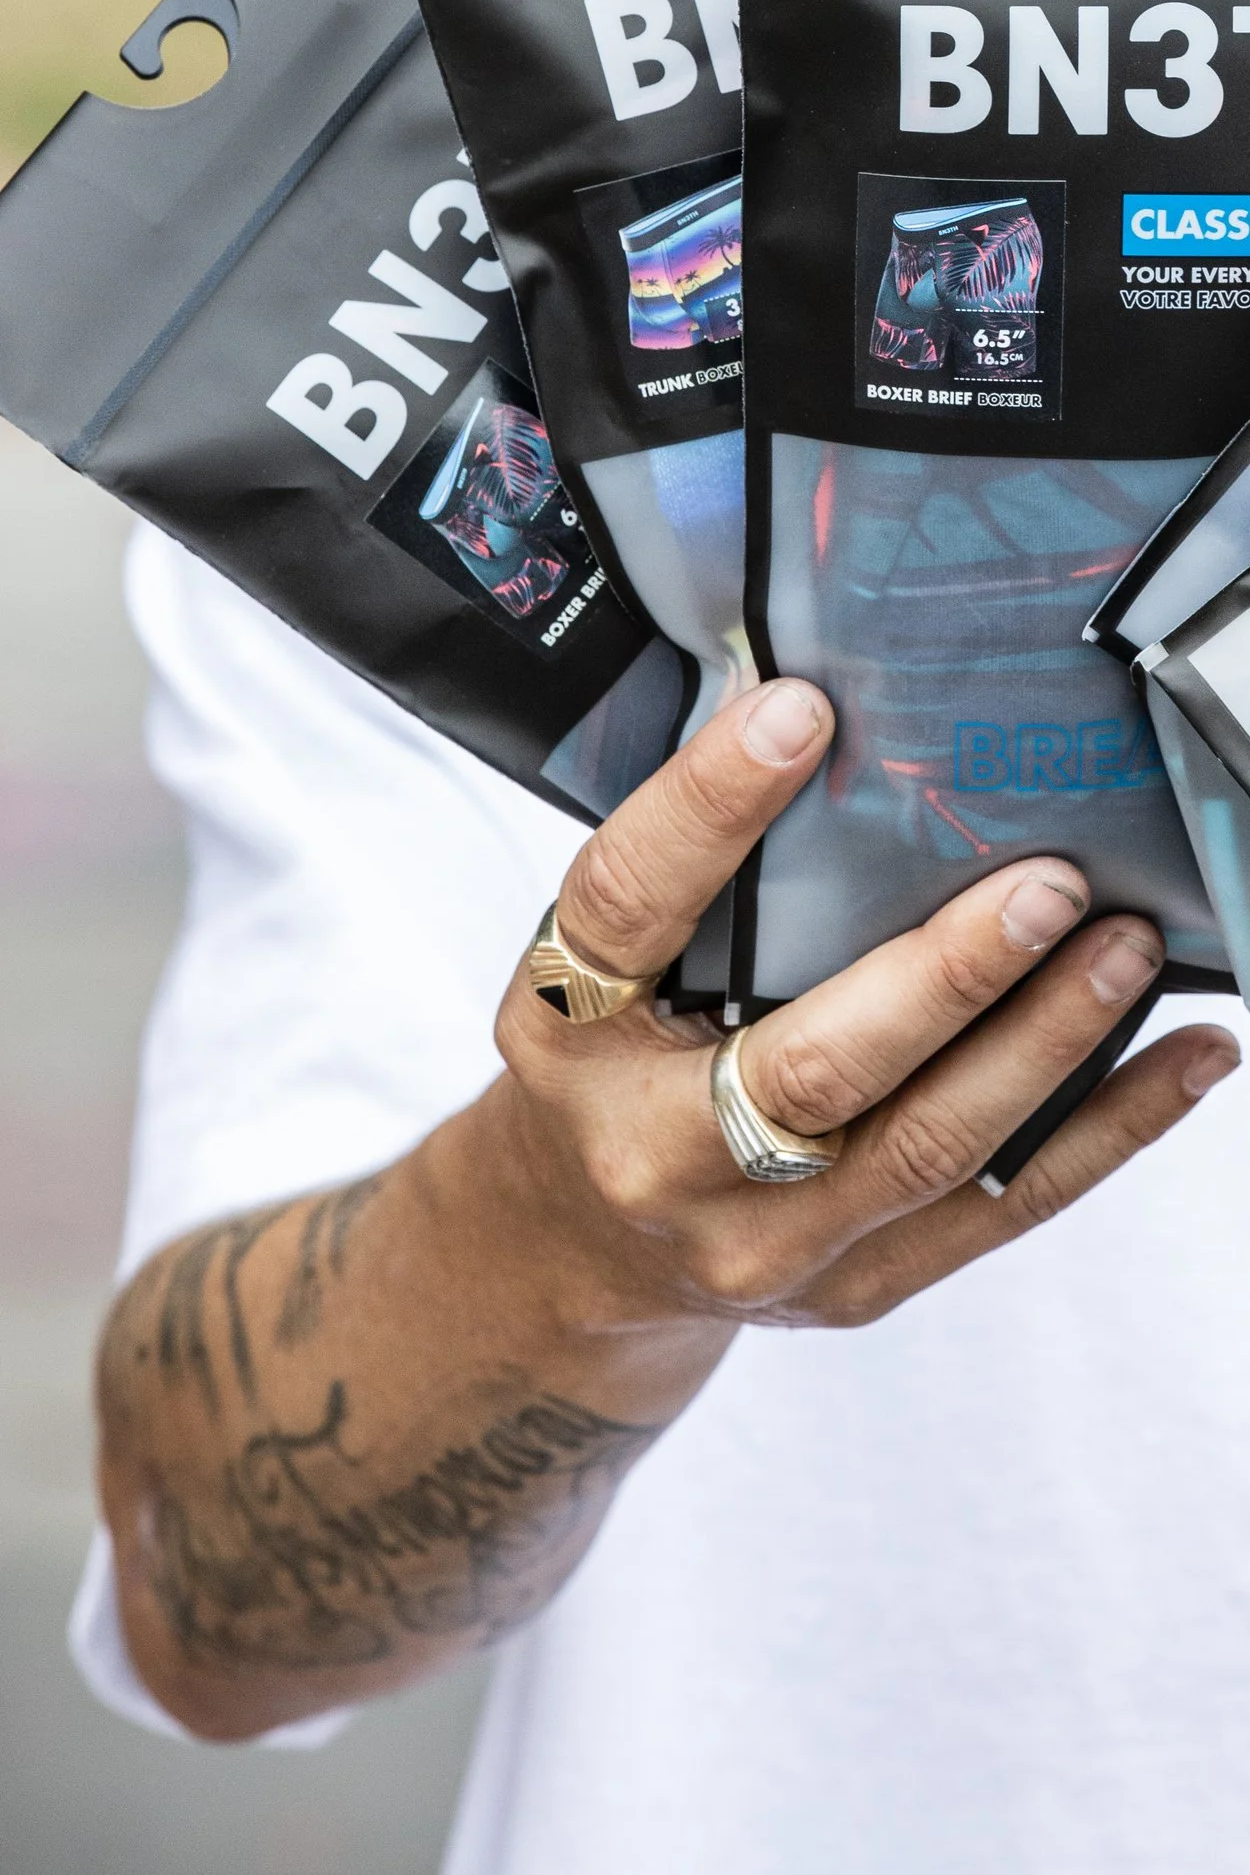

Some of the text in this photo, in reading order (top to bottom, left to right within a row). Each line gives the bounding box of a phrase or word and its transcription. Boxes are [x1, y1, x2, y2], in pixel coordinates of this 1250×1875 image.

[1121, 266, 1184, 284] YOUR
[1119, 289, 1191, 309] VOTRE
[266, 148, 513, 481] BN3
[638, 373, 695, 399] TRUNK
[866, 384, 1043, 408] BOXER BRIEF BOXEUR
[540, 595, 588, 648] BOXER
